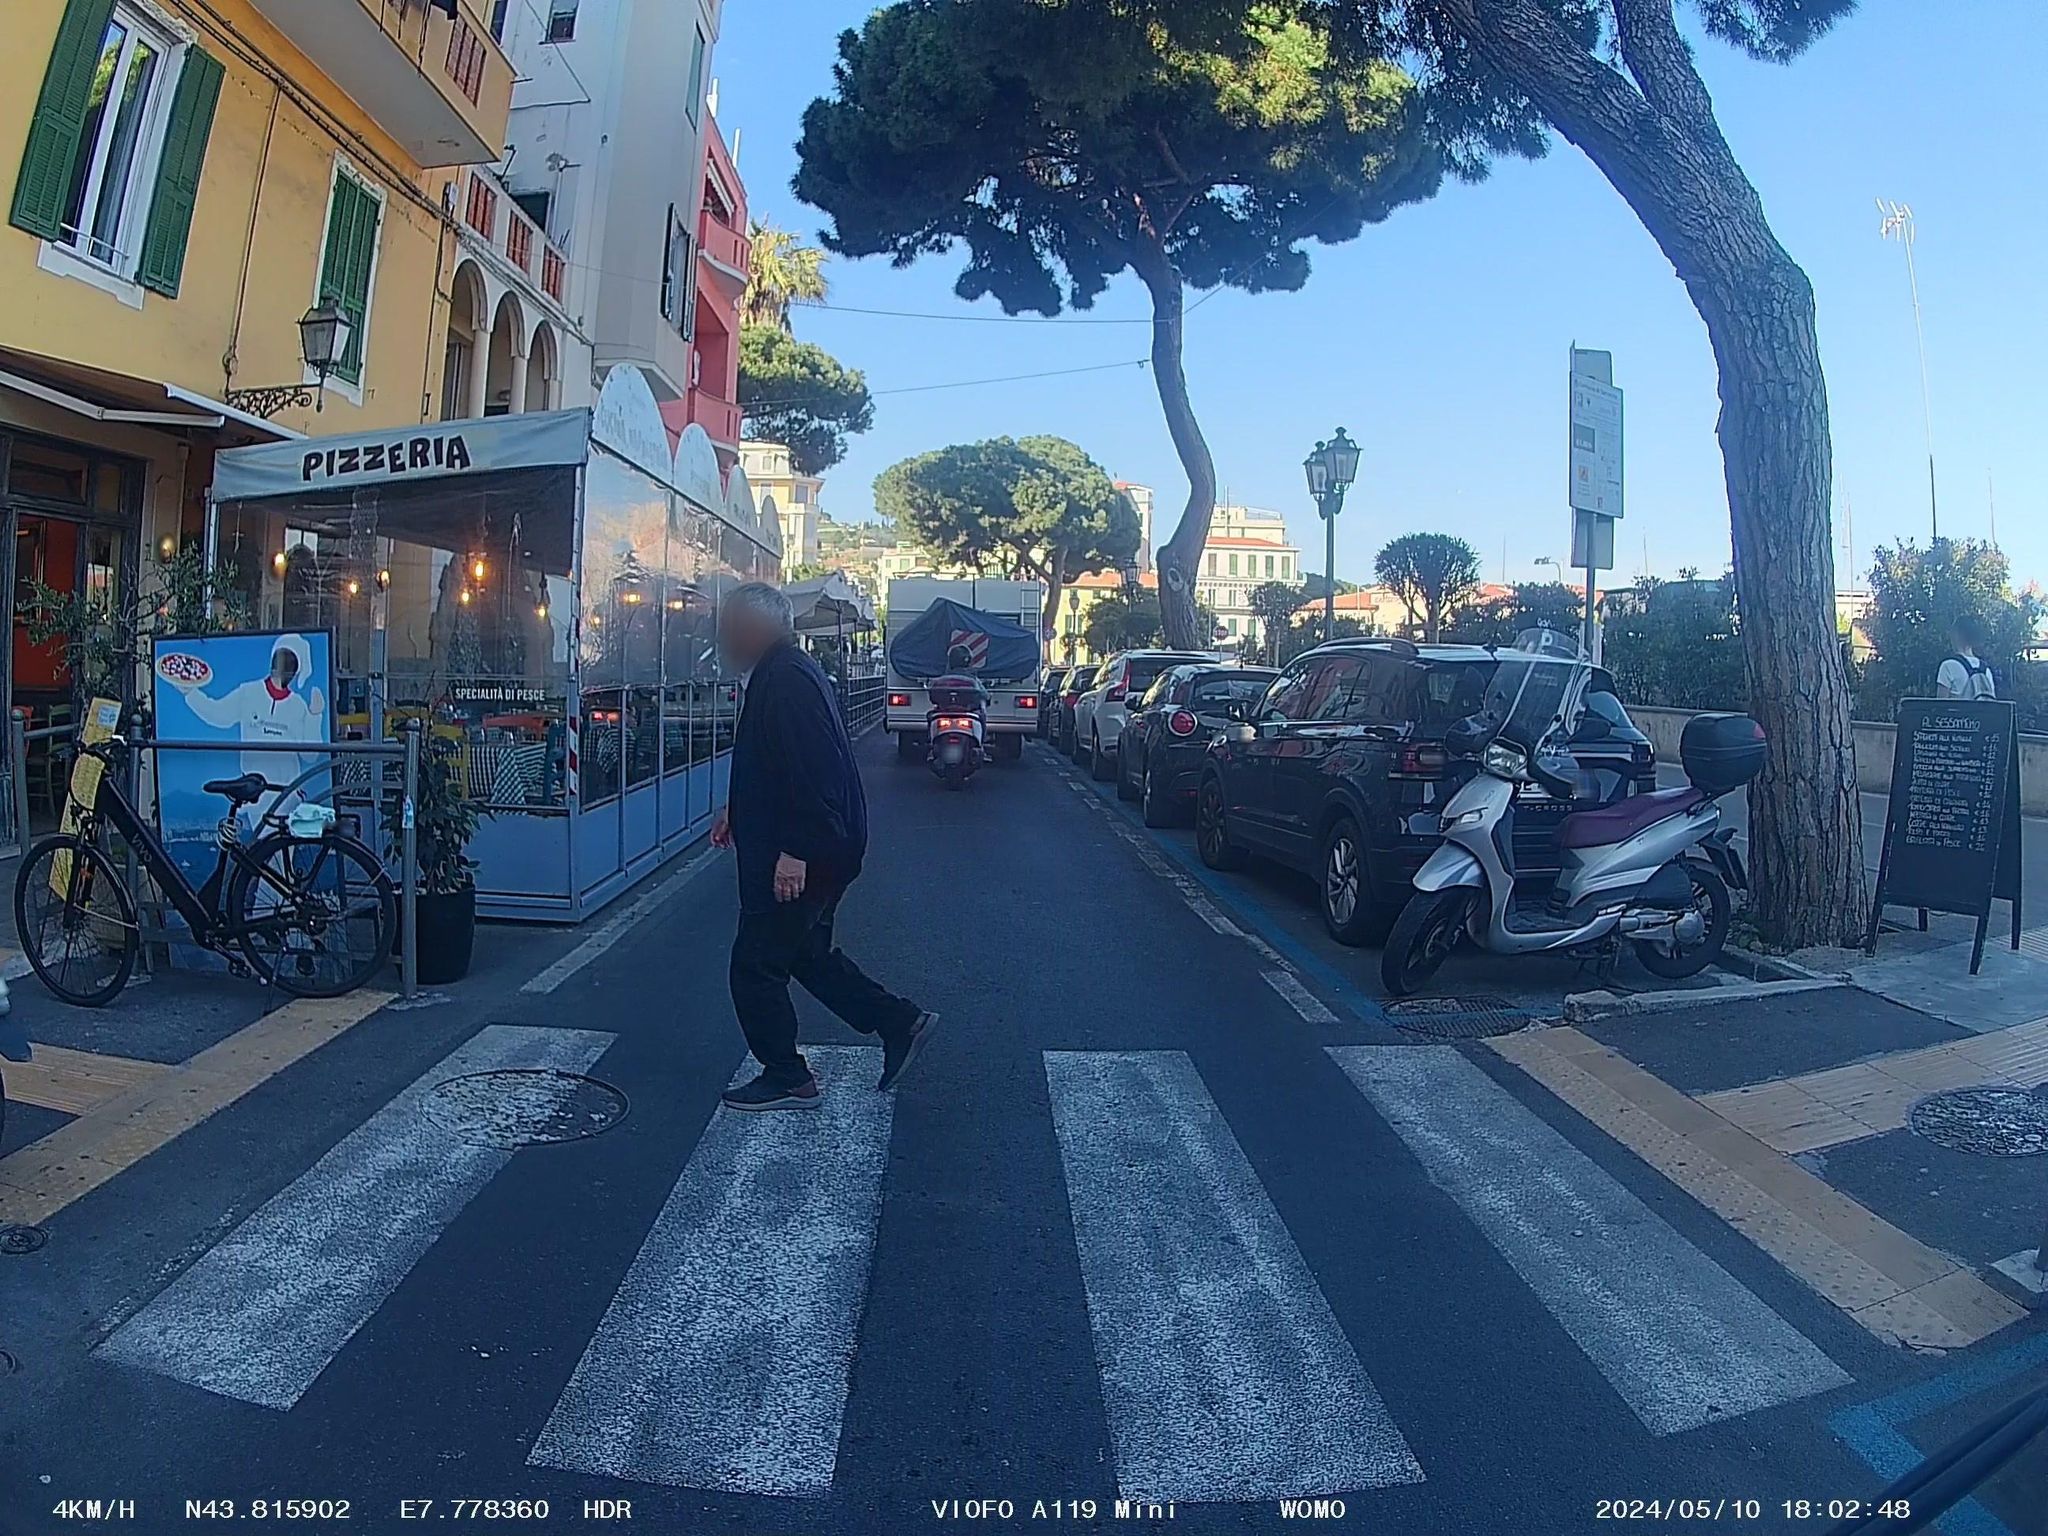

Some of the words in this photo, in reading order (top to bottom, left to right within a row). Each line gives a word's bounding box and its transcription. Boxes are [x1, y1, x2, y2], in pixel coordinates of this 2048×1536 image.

[302, 435, 471, 482] PIZZERIA
[455, 686, 503, 700] SPECIALITÀ
[505, 688, 515, 700] DI
[517, 688, 545, 701] PESCE
